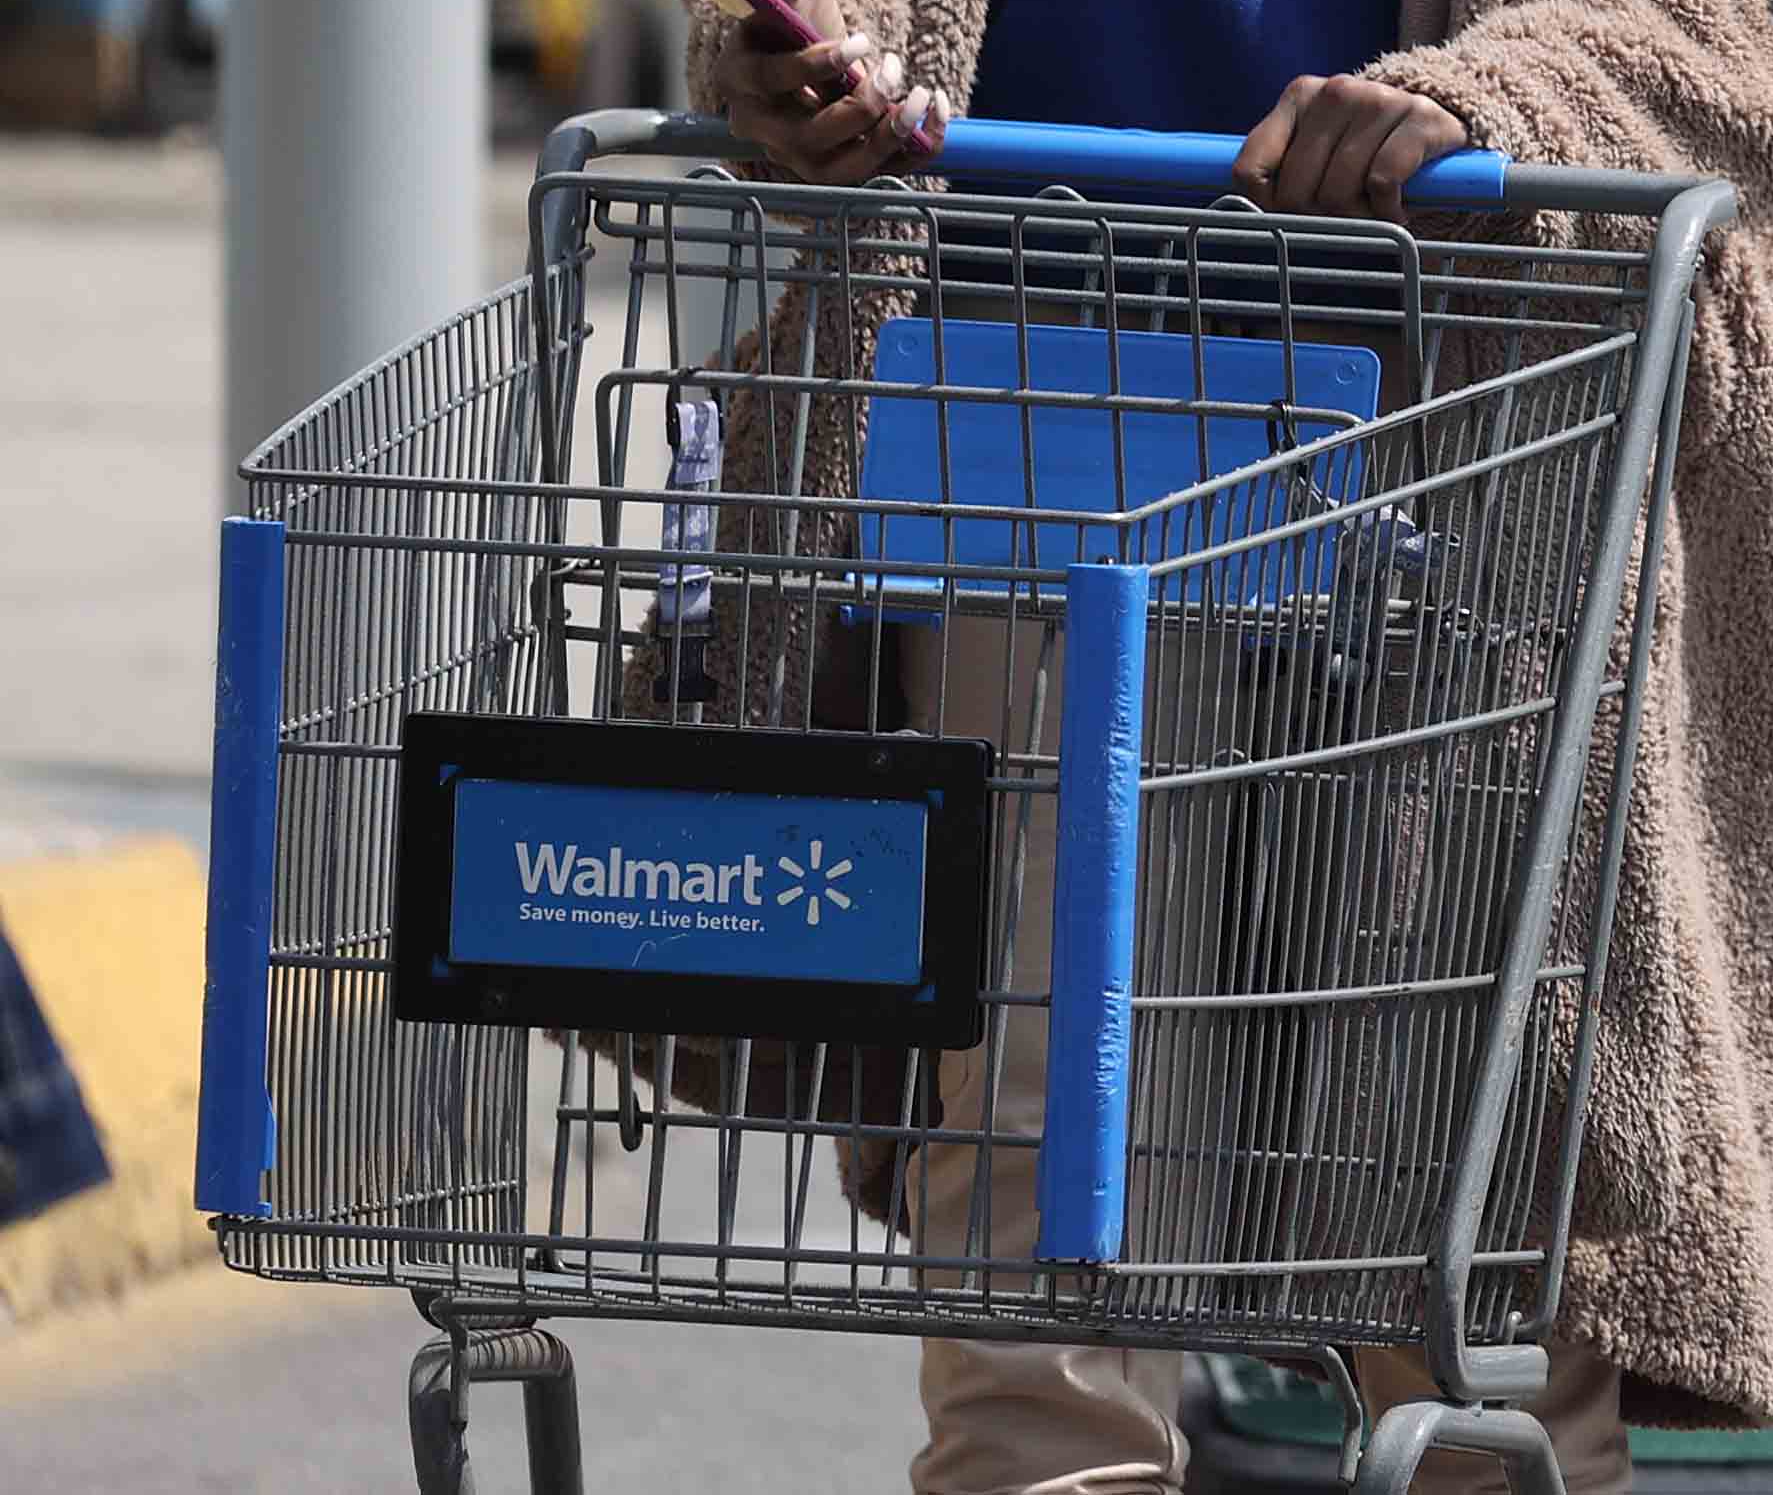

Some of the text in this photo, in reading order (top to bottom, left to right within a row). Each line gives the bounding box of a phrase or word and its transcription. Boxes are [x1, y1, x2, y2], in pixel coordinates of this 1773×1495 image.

[515, 841, 764, 906] Walmart
[519, 902, 765, 933] Save money. Live better.
